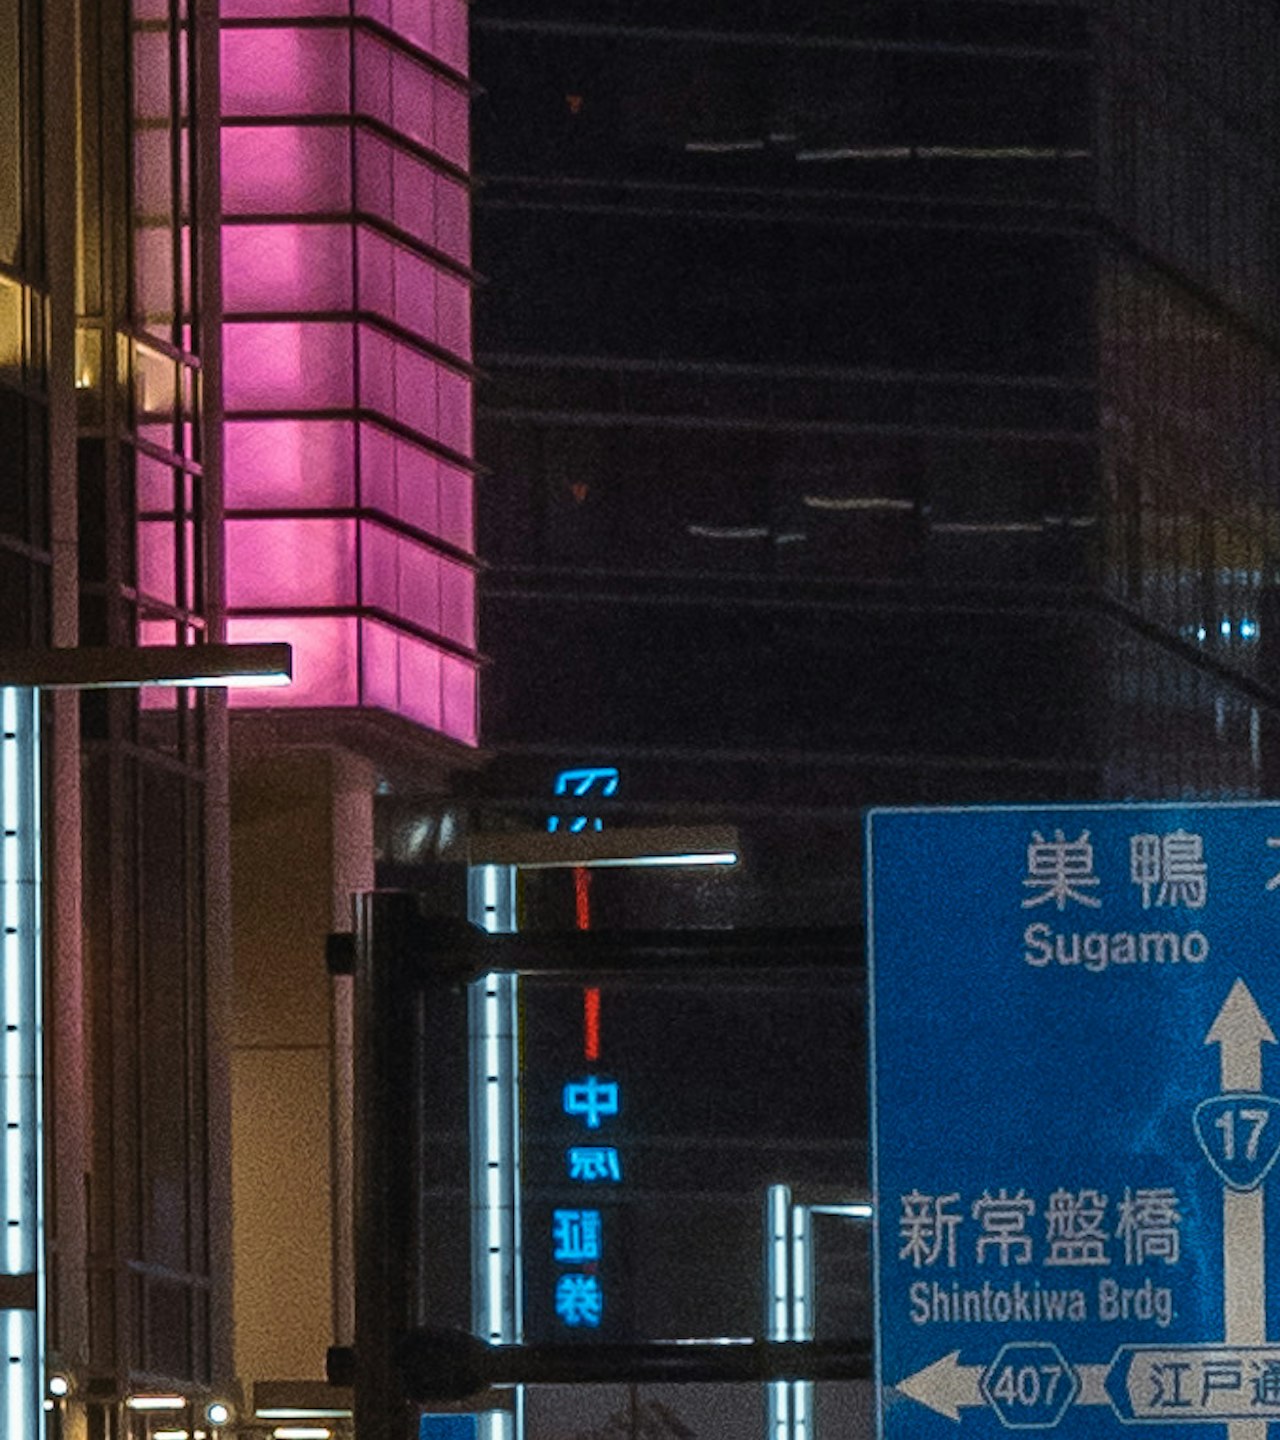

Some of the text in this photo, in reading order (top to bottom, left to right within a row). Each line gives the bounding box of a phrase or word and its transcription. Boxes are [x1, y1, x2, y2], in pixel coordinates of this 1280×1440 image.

[1021, 829, 1208, 911] 巣鴨
[1023, 922, 1210, 971] Sugamo
[1214, 1110, 1270, 1161] 17
[898, 1188, 1181, 1269] 新常盤橋
[909, 1281, 1086, 1324] Shintokiwa
[993, 1366, 1063, 1407] 407
